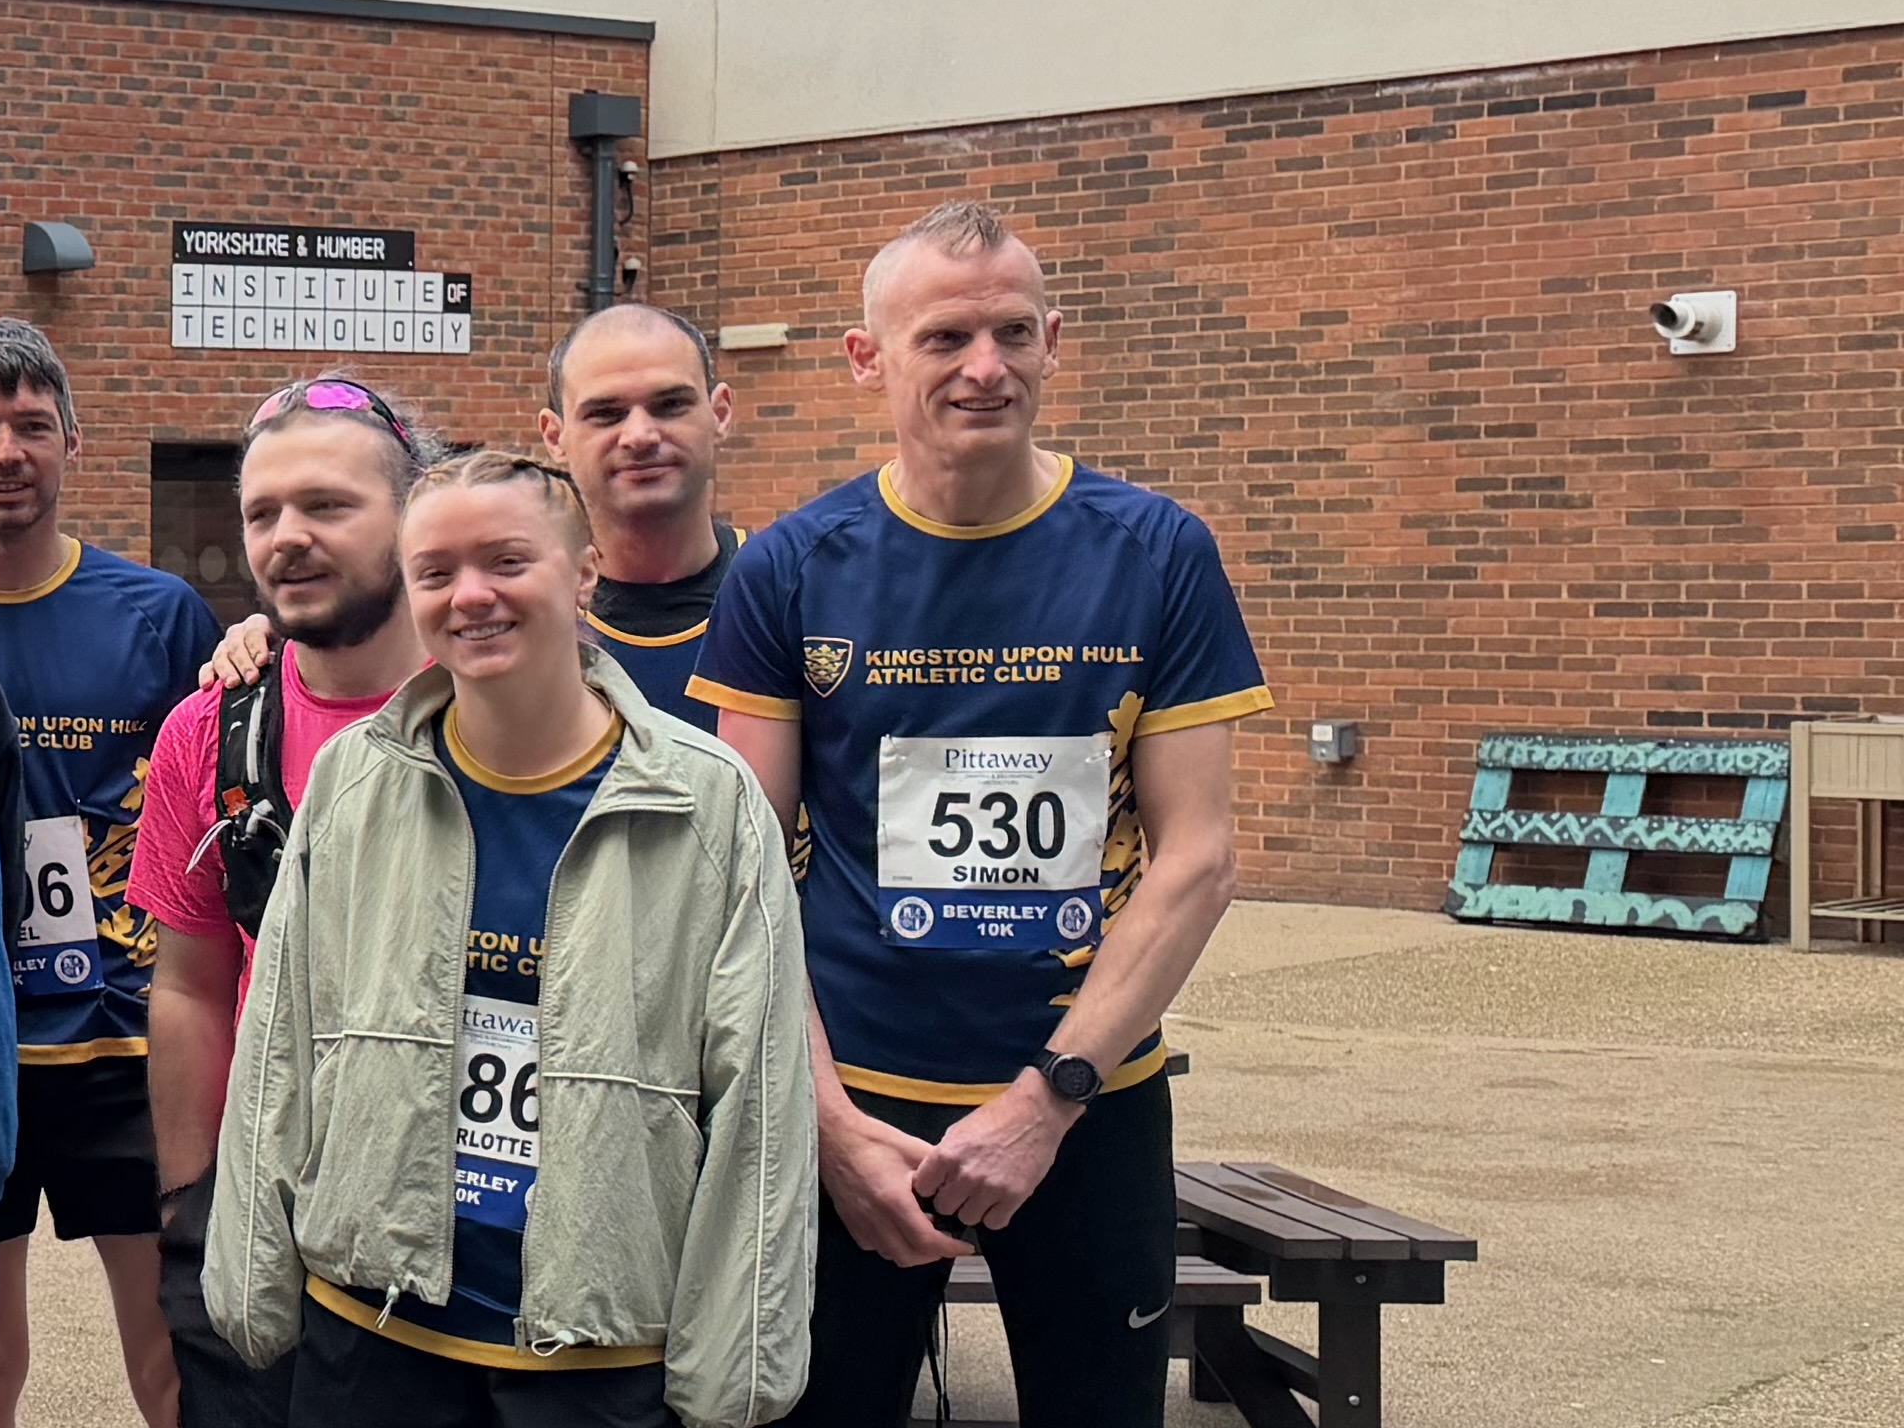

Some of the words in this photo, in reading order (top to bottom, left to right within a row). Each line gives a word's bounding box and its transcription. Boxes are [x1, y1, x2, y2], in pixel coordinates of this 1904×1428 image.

[182, 230, 289, 258] YORKSHIRE
[297, 236, 308, 257] &
[316, 235, 385, 260] HUMBER
[181, 272, 435, 303] INSTITUTE
[447, 282, 467, 303] OF
[181, 314, 462, 344] TECHNOLOGY
[865, 649, 994, 666] KINGSTON
[1002, 646, 1073, 664] UPON
[1082, 646, 1144, 663] HULL
[865, 667, 986, 685] ATHLETIC
[994, 665, 1061, 683] CLUB
[42, 716, 104, 733] UPON
[36, 733, 93, 750] CLUB
[944, 748, 1053, 774] Pittaway
[927, 791, 1066, 860] 530
[952, 865, 1040, 884] SIMON
[942, 905, 1049, 922] BEVERLEY
[977, 923, 1015, 939] 10K
